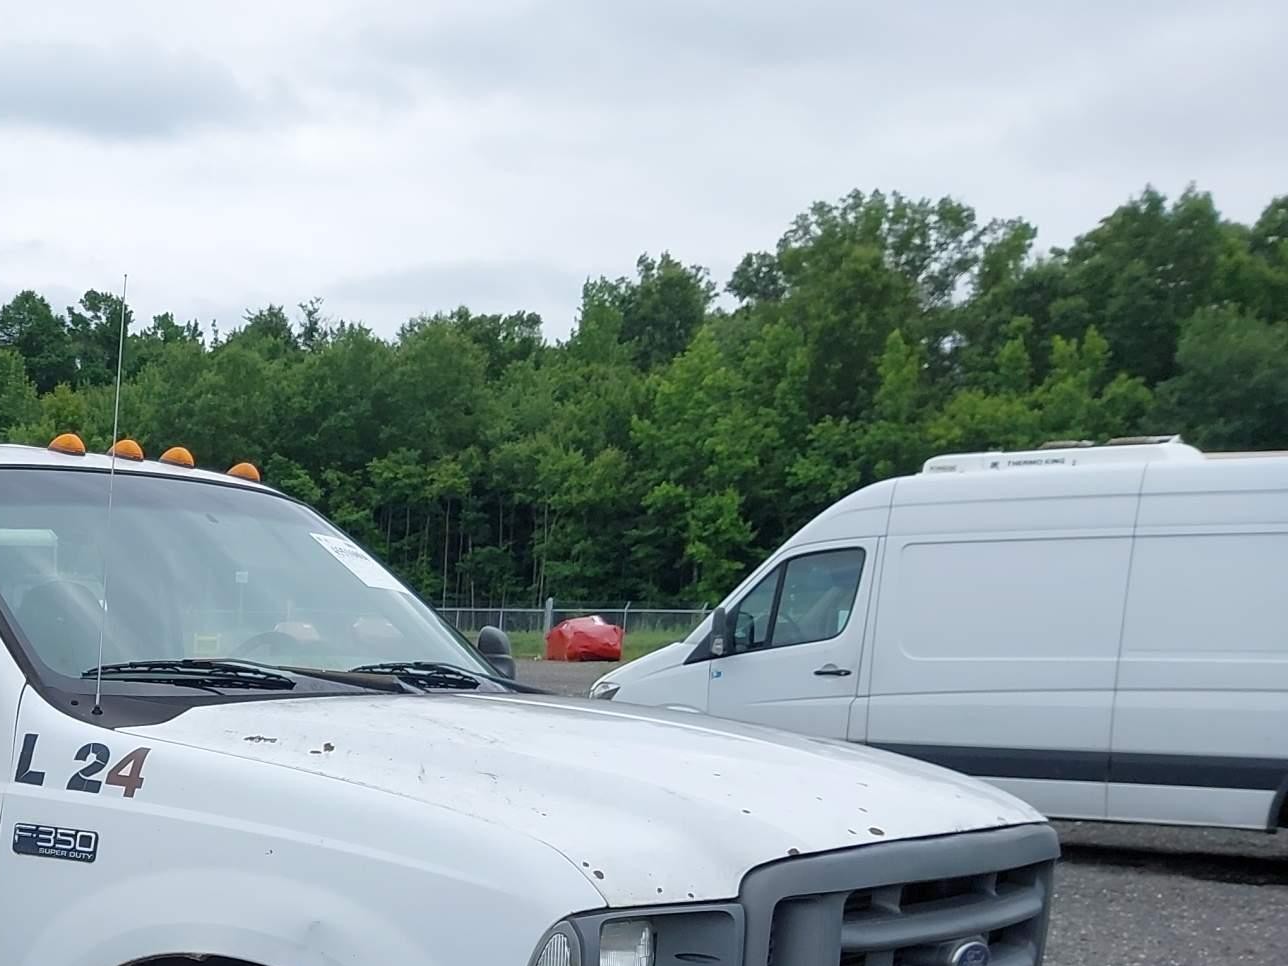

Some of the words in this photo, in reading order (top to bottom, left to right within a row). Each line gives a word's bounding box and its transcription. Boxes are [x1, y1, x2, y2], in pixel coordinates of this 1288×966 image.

[15, 733, 46, 786] L
[66, 742, 152, 798] 24
[38, 847, 67, 857] SUPER
[69, 851, 93, 860] DUTY
